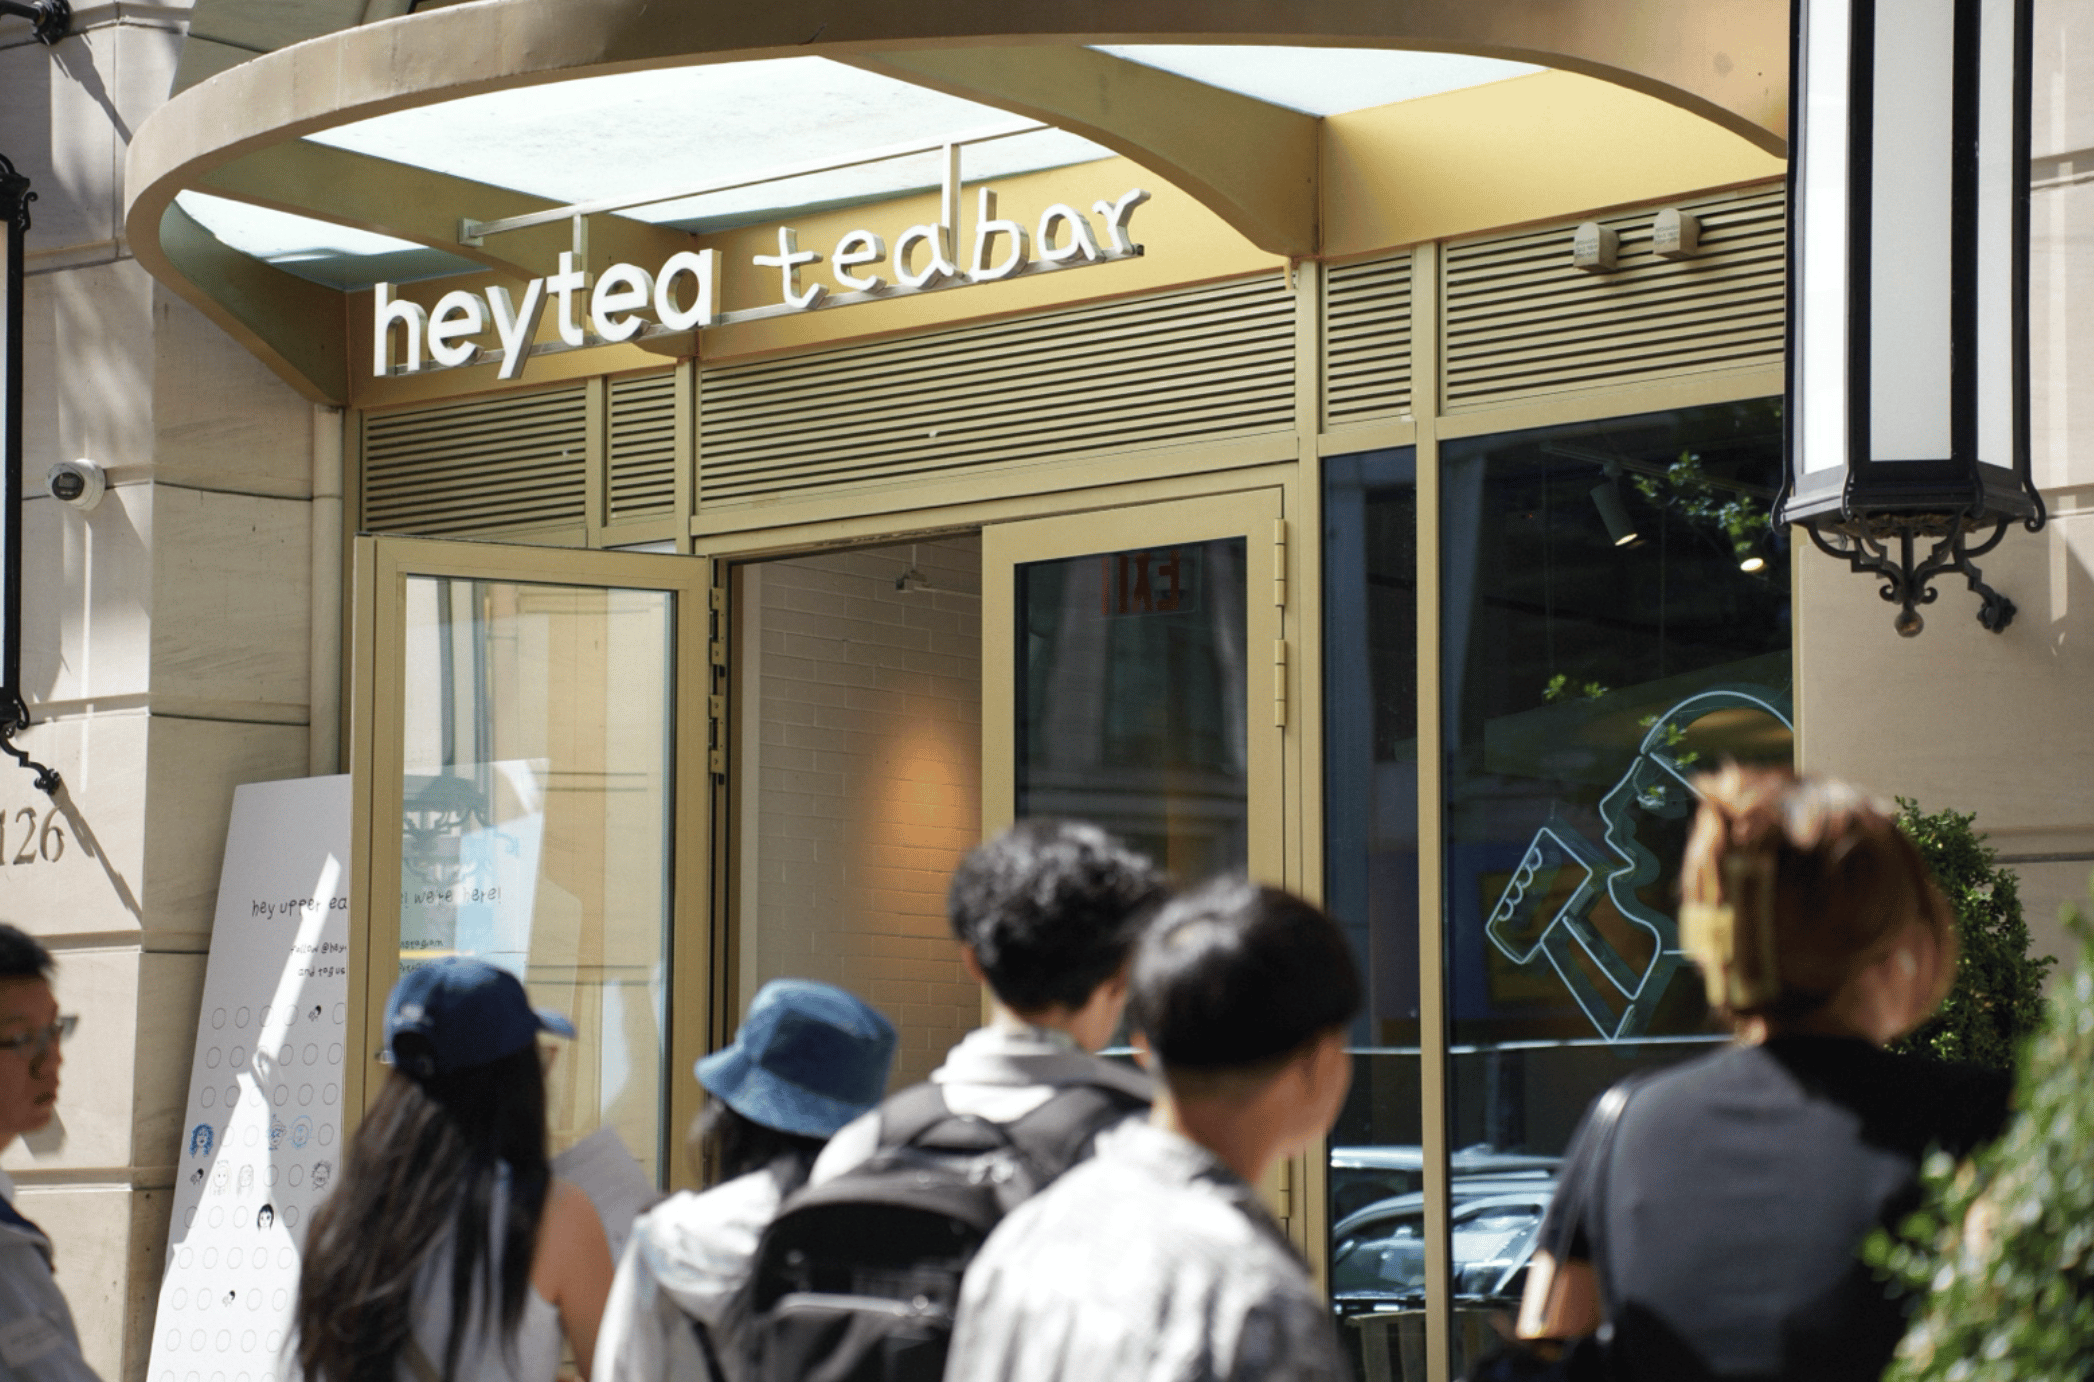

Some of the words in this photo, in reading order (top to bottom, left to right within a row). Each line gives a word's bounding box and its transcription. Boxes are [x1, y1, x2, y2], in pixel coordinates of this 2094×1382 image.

[374, 247, 722, 379] heytea
[753, 187, 1152, 310] teabar
[251, 899, 276, 920] hey
[280, 898, 321, 917] upper
[328, 897, 348, 910] ea
